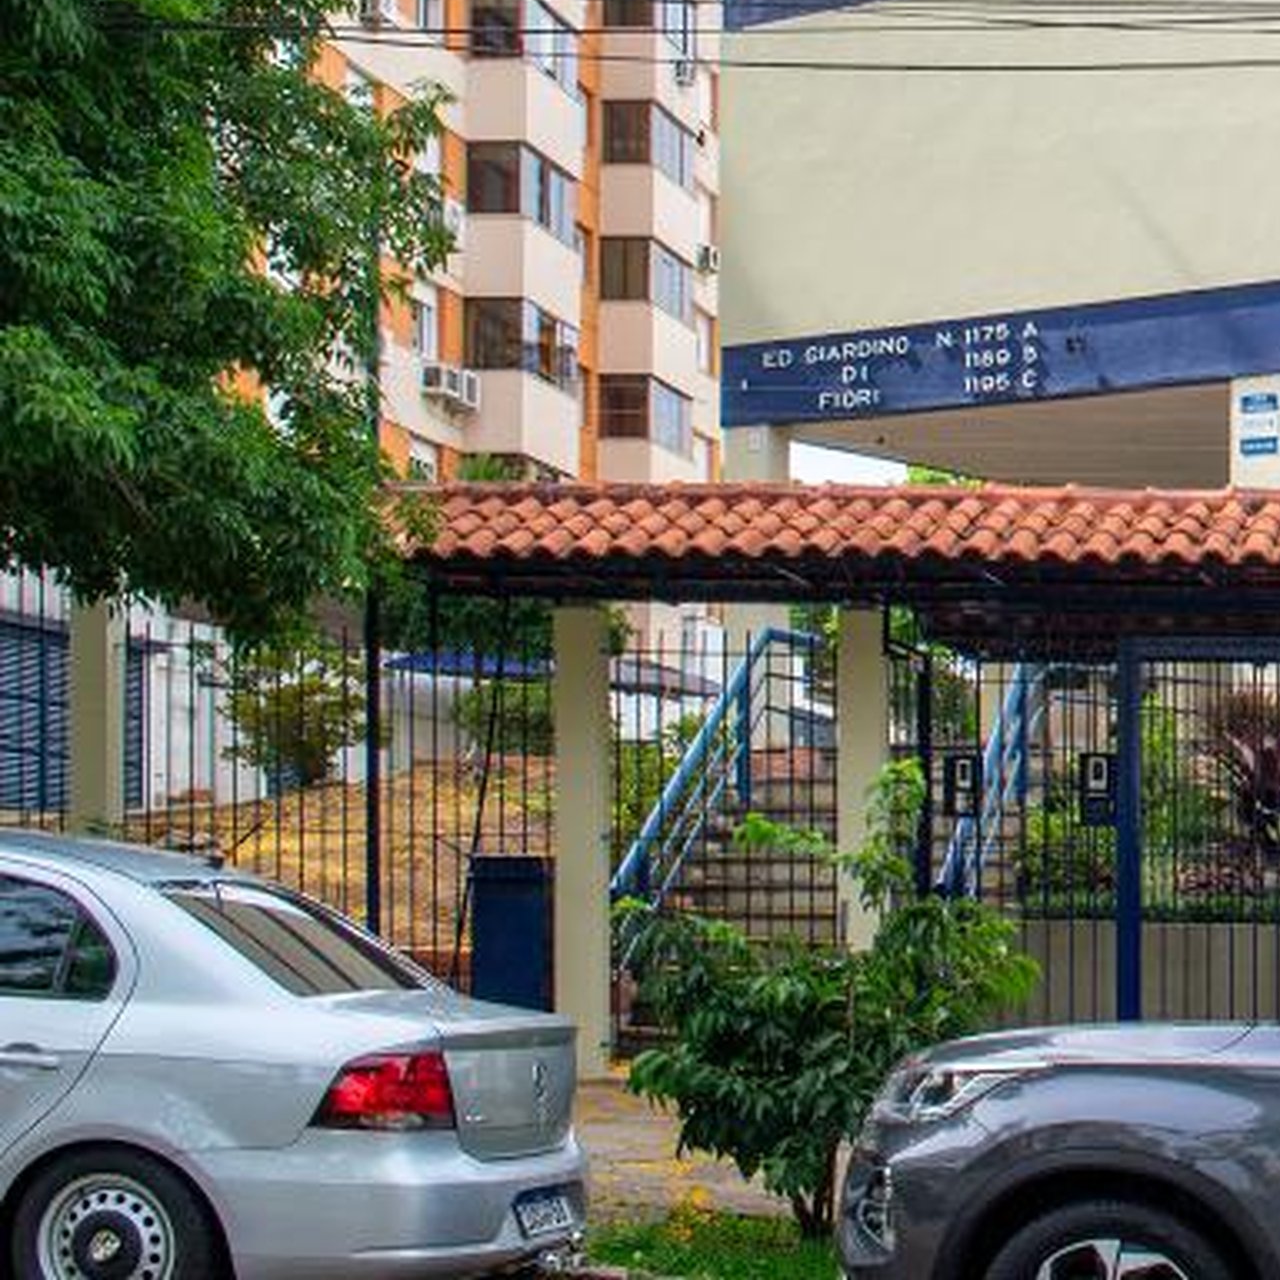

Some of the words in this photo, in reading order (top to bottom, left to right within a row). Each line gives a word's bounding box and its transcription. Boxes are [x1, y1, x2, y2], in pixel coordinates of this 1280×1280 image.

[1022, 321, 1038, 338] A
[762, 349, 793, 368] ED
[805, 336, 909, 364] GIARDINO
[1023, 345, 1038, 364] B
[842, 365, 868, 384] DI
[1022, 369, 1037, 388] C
[819, 389, 880, 410] FIORI
